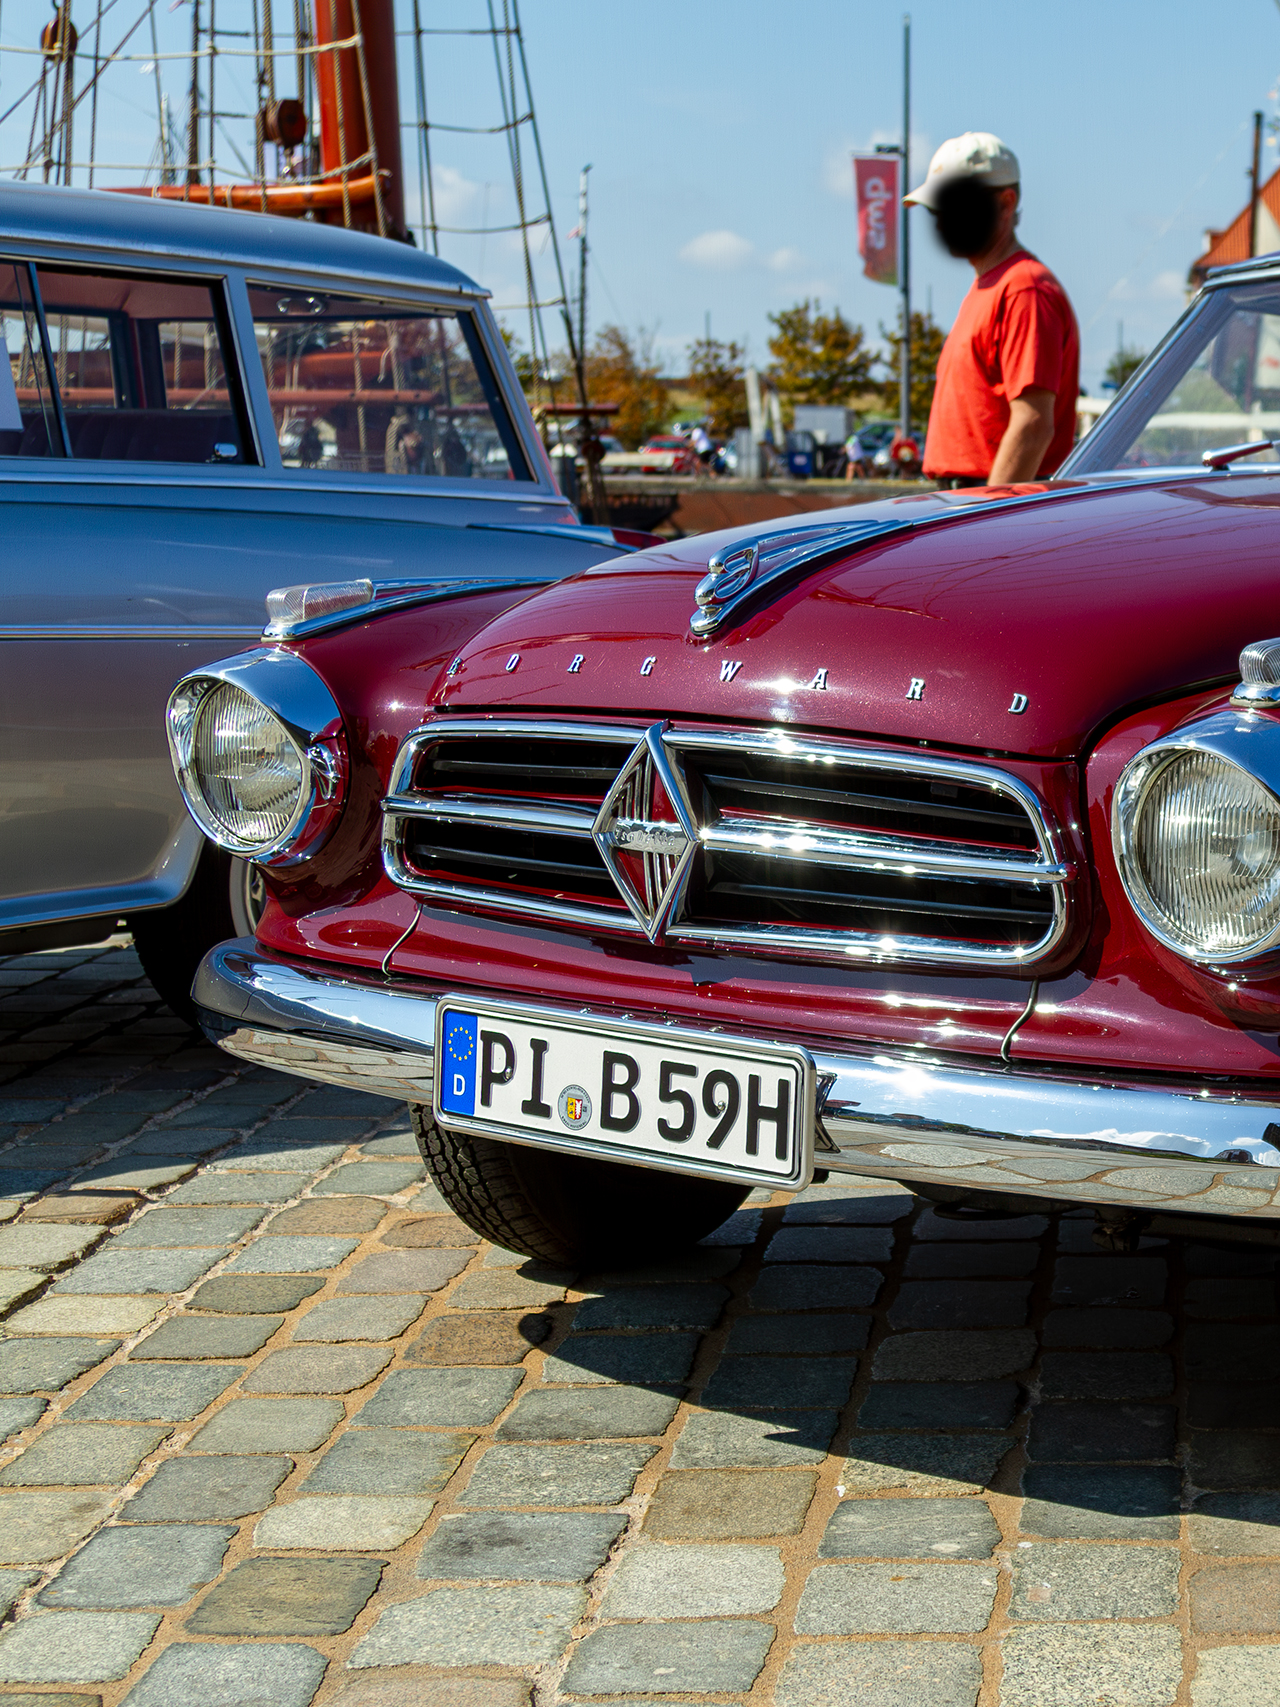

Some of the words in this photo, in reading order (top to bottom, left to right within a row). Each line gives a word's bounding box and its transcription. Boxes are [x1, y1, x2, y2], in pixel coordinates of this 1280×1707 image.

[447, 654, 1029, 714] BORGWARD
[453, 1073, 465, 1096] D
[480, 1030, 551, 1118] PI
[601, 1050, 641, 1132] B
[658, 1060, 790, 1161] 59H
